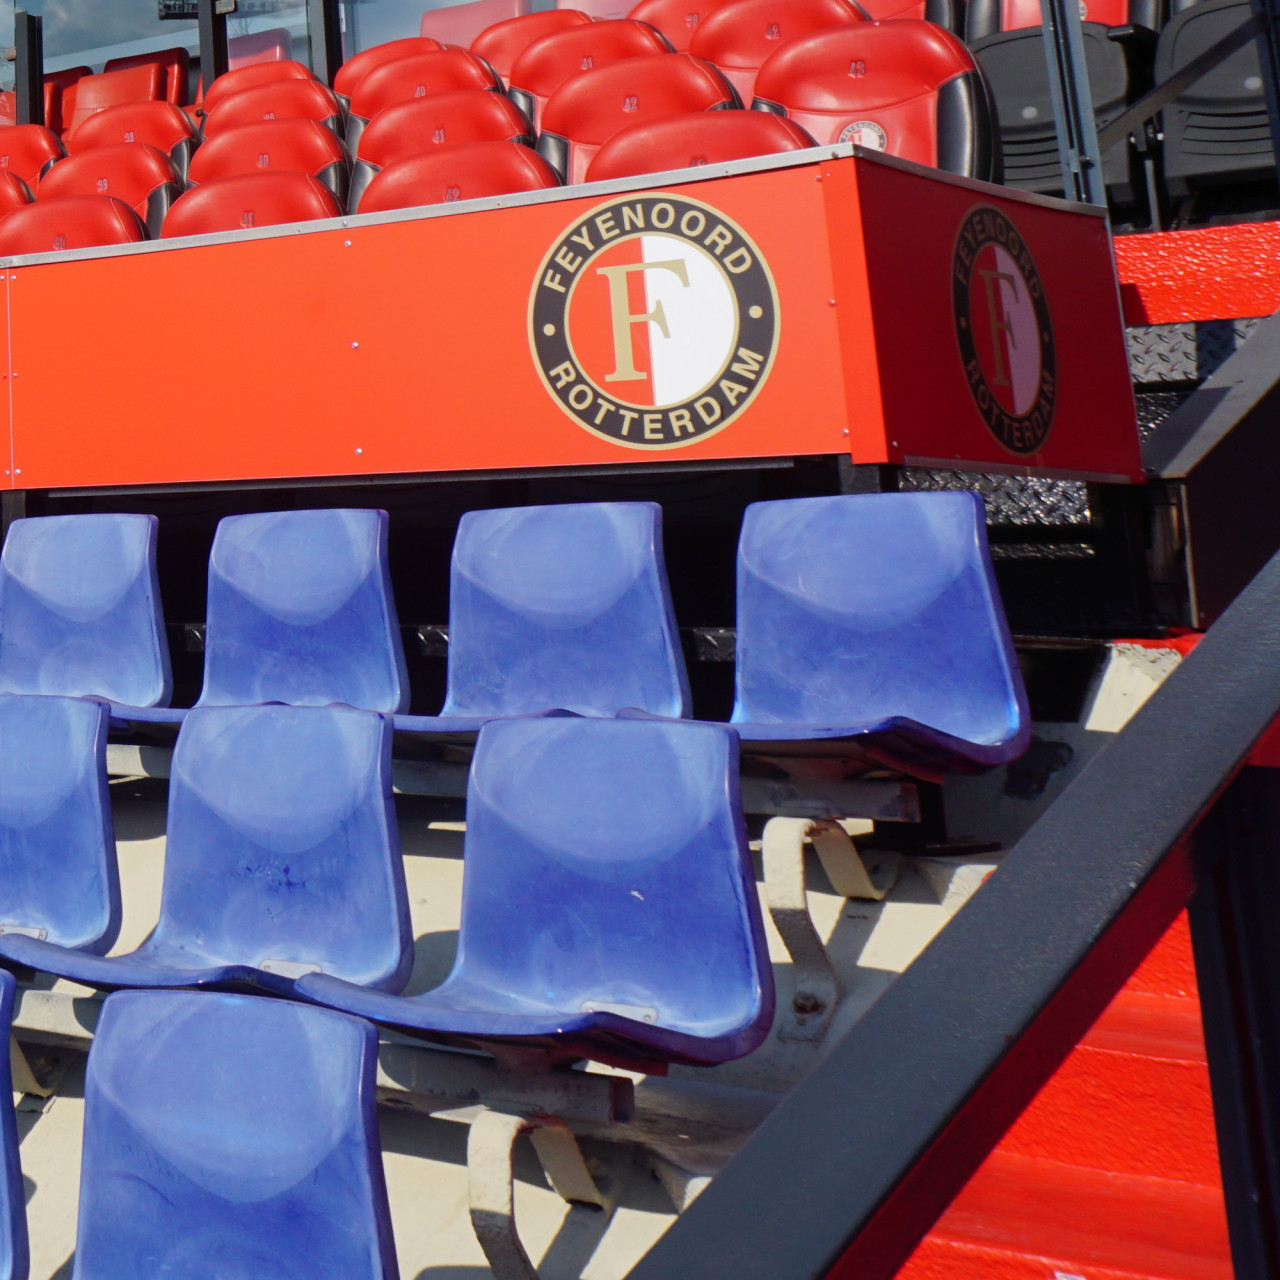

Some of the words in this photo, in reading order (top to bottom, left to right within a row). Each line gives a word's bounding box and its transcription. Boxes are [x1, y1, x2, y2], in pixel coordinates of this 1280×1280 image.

[764, 24, 781, 40] 42
[848, 60, 866, 78] 43
[623, 96, 638, 112] 42
[543, 201, 753, 294] FEYENOORD
[955, 212, 1040, 300] FEYENOORD
[596, 258, 692, 383] F
[978, 269, 1019, 387] F
[549, 346, 765, 441] ROTTERDAM
[967, 358, 1055, 448] ROTTERDAM
